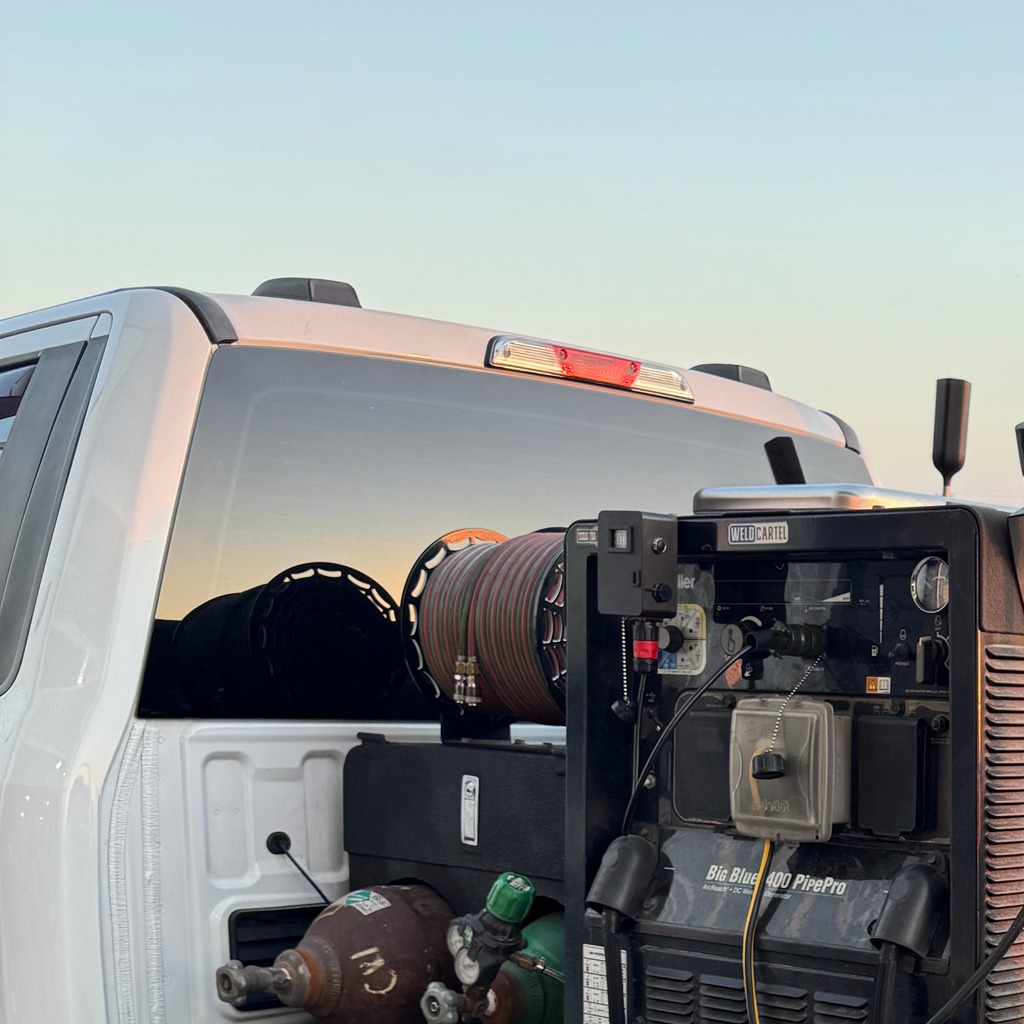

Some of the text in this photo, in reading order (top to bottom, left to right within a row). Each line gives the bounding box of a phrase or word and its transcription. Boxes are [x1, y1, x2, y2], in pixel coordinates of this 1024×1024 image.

[730, 526, 787, 541] WELD CARTEL
[677, 574, 696, 589] ller
[706, 865, 847, 895] Big Blue 400 PipePro
